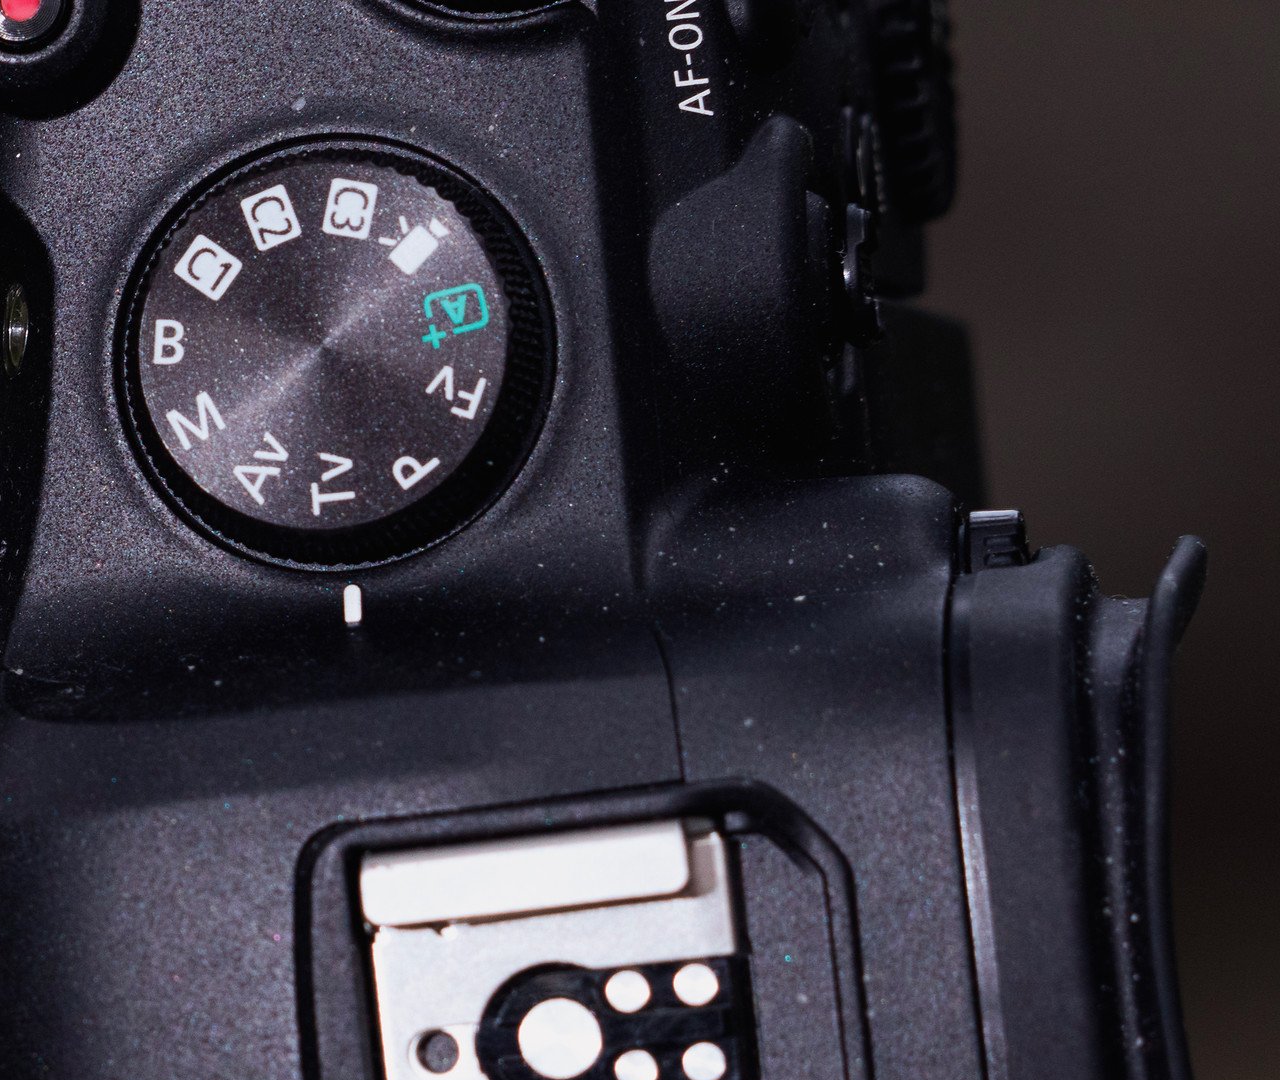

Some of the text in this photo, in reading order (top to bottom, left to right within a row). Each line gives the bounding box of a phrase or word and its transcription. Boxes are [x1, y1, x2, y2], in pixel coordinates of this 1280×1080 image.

[247, 191, 296, 247] C2
[327, 184, 372, 236] C3
[184, 244, 232, 295] C1
[153, 319, 184, 365] B
[425, 365, 487, 420] Fv
[165, 391, 226, 451] M
[232, 431, 289, 505] Av
[311, 452, 356, 516] Tv
[392, 456, 440, 491] P
